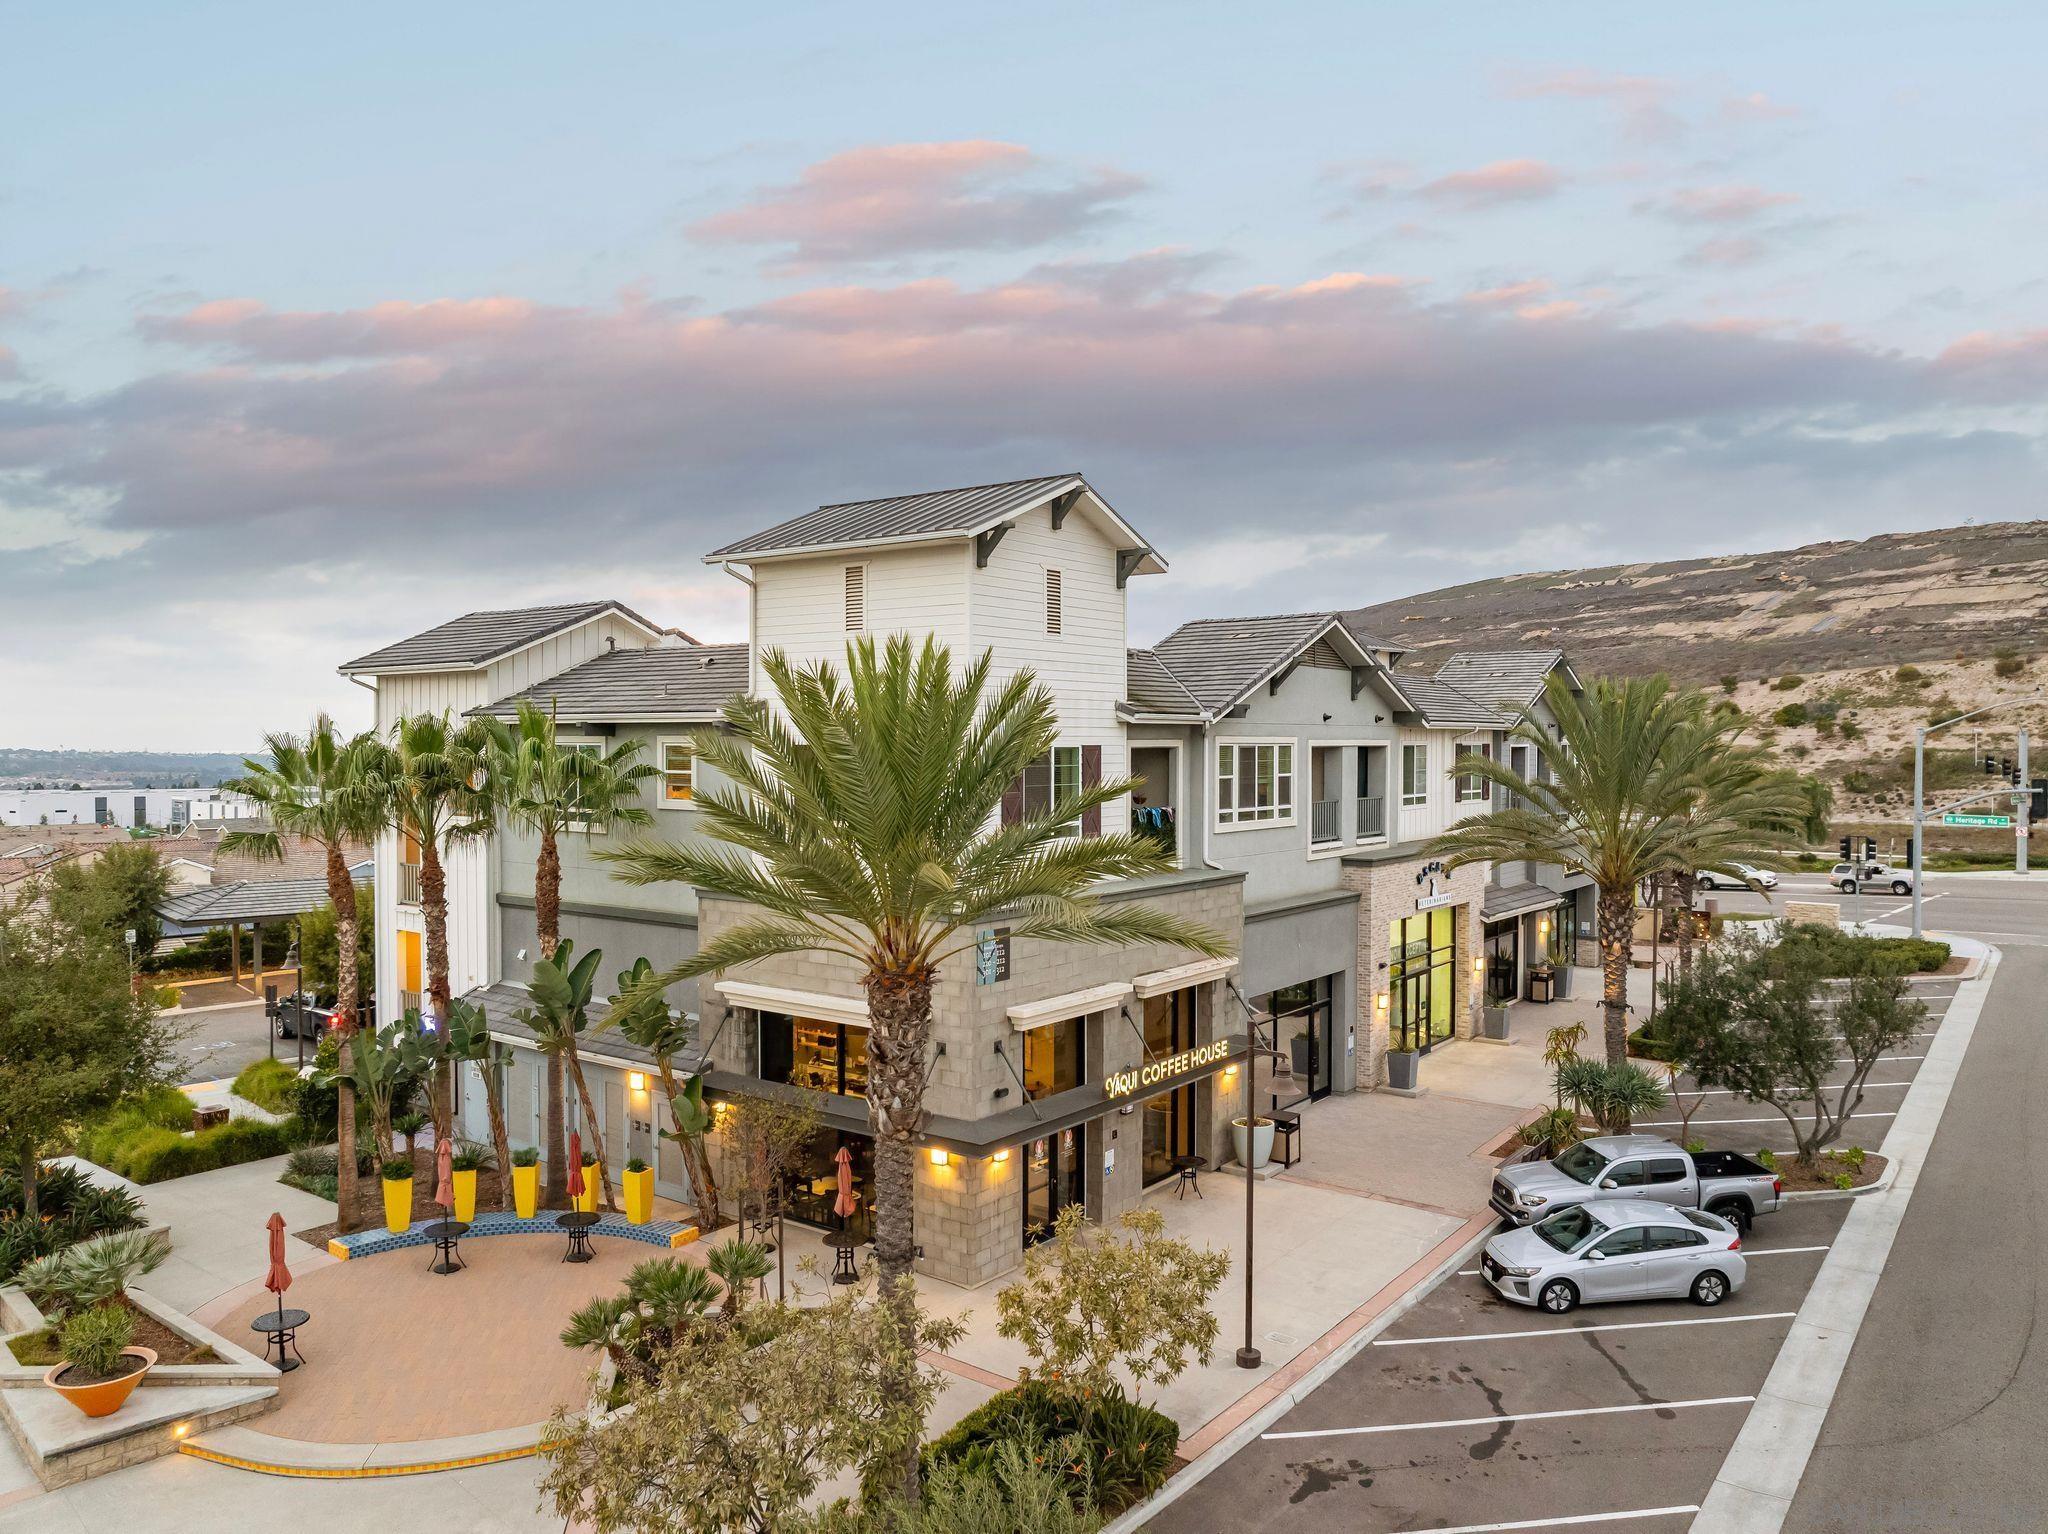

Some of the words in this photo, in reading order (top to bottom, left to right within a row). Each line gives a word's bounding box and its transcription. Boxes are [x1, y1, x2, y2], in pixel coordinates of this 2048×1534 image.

[1955, 816, 1985, 825] Heritage
[1105, 1070, 1138, 1099] YAQUI
[1141, 1053, 1189, 1086] COFFEE
[1190, 1040, 1228, 1069] HOUSE
